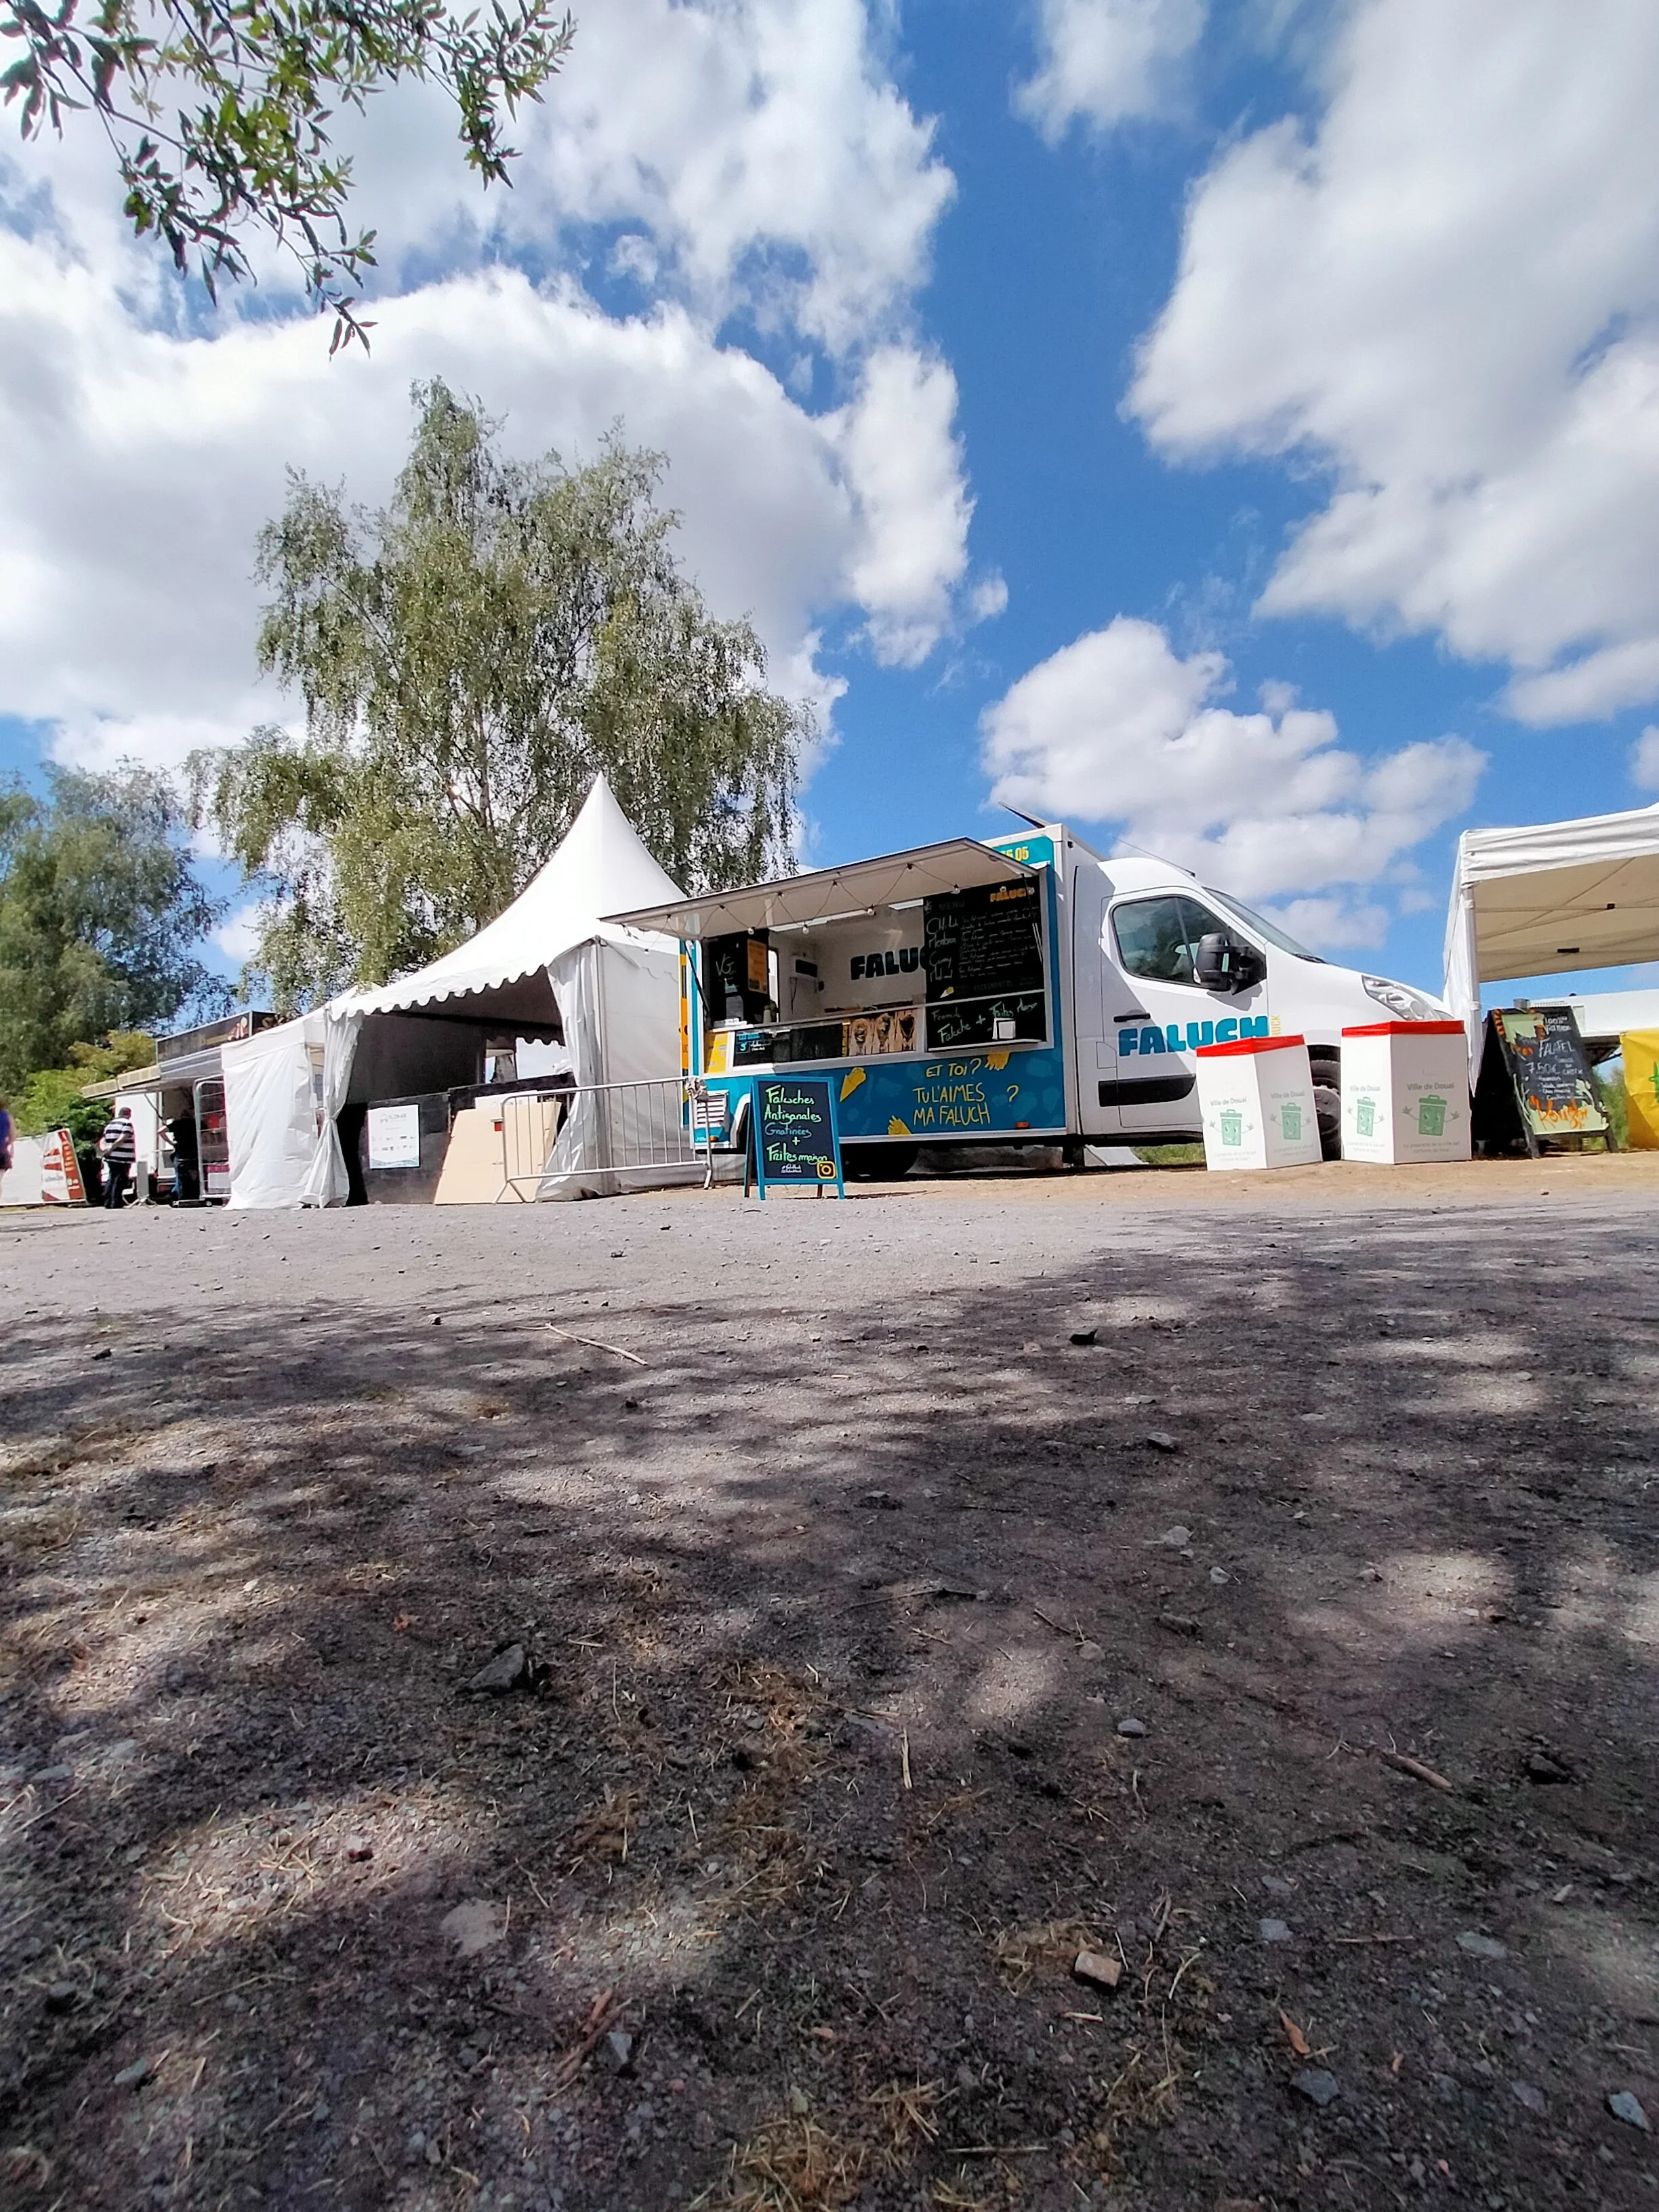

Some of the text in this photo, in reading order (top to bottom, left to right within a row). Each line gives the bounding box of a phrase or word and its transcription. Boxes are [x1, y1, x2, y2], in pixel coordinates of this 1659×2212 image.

[990, 888, 1034, 902] FALUC
[1118, 1015, 1269, 1057] FALUCH
[926, 1065, 943, 1078] ET
[765, 1084, 815, 1105] Faluches
[1006, 1084, 1019, 1107] ?
[914, 1101, 990, 1126] MA FALUCH
